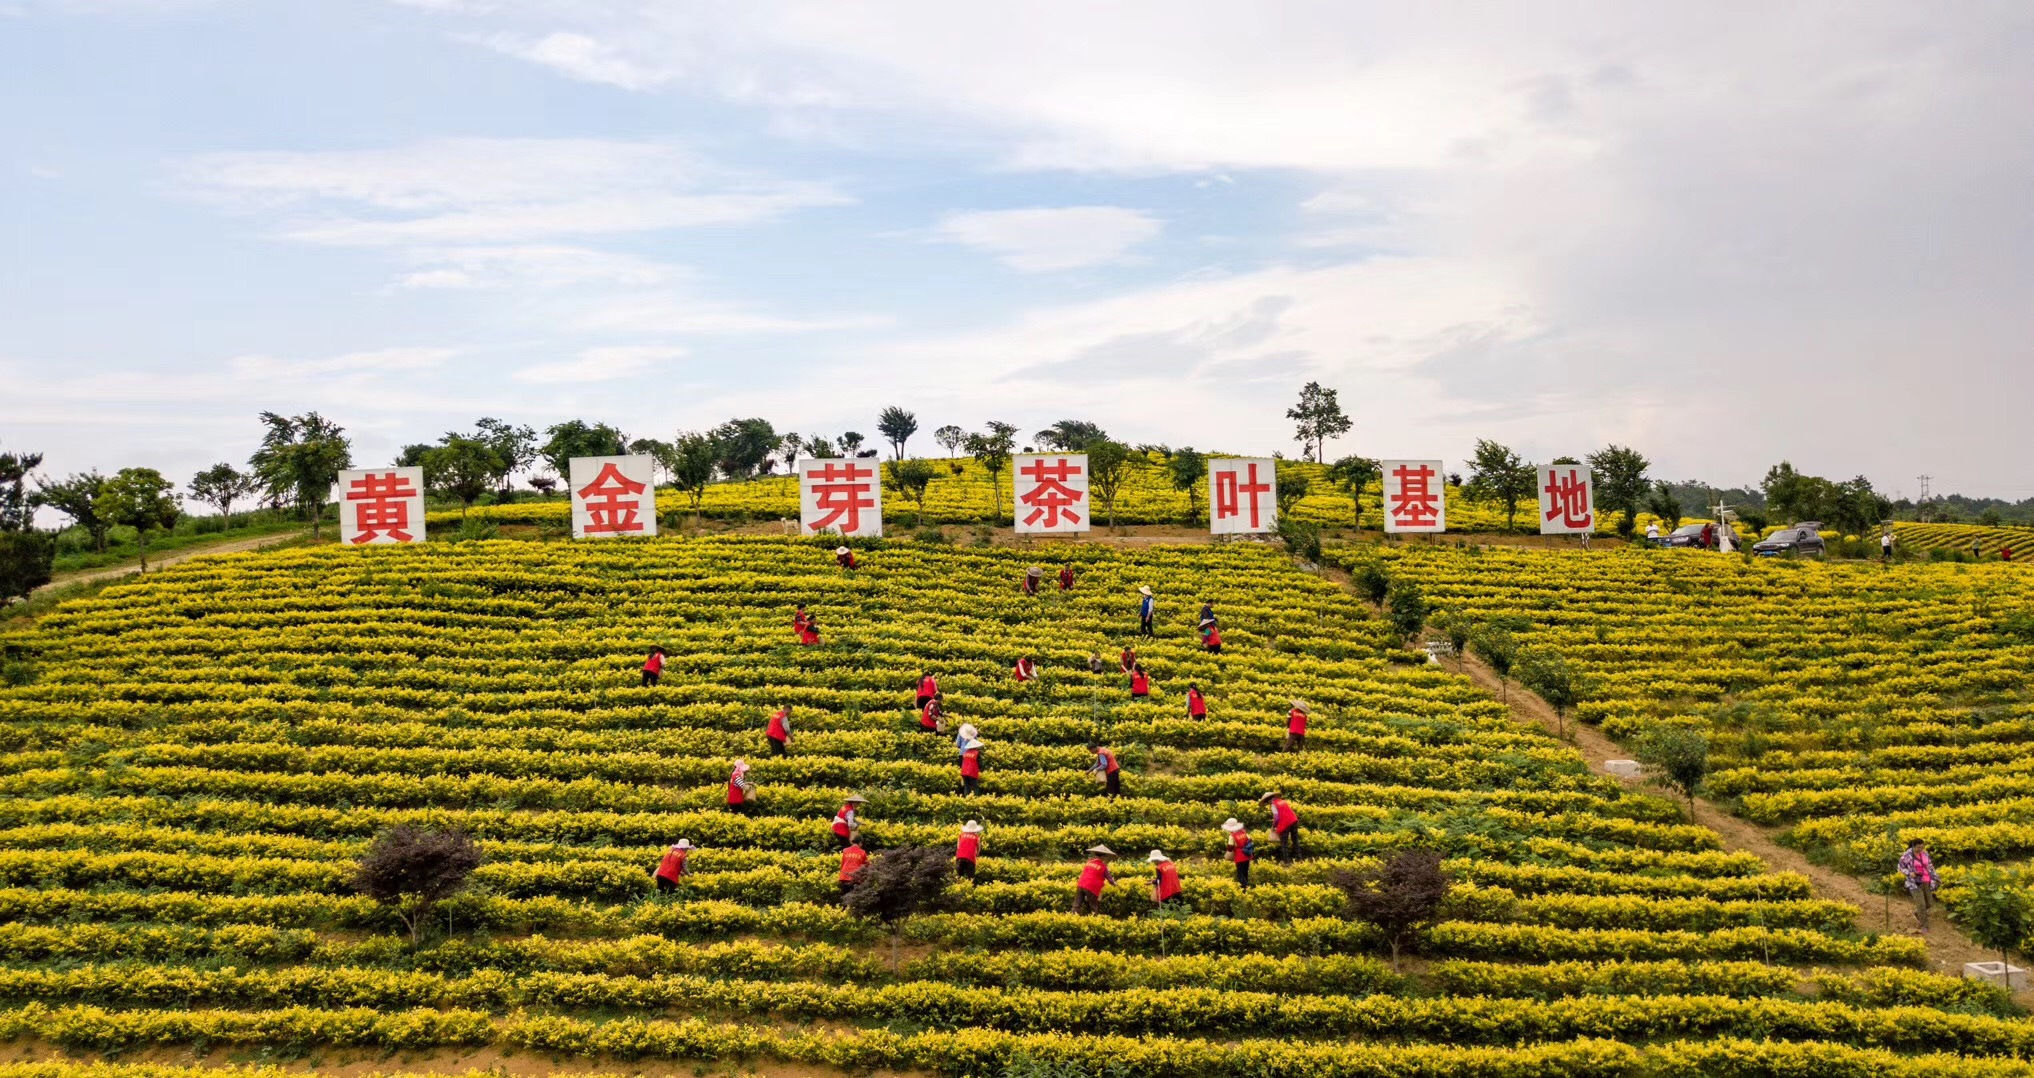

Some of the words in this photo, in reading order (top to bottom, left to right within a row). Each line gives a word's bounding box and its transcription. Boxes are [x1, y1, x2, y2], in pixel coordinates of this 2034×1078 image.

[347, 473, 417, 544] 黄
[578, 464, 645, 533] 金
[808, 463, 874, 533] 芽
[1021, 459, 1082, 528] 茶
[1216, 463, 1270, 528] 叶
[1391, 464, 1438, 526] 基
[1545, 469, 1591, 528] 地
